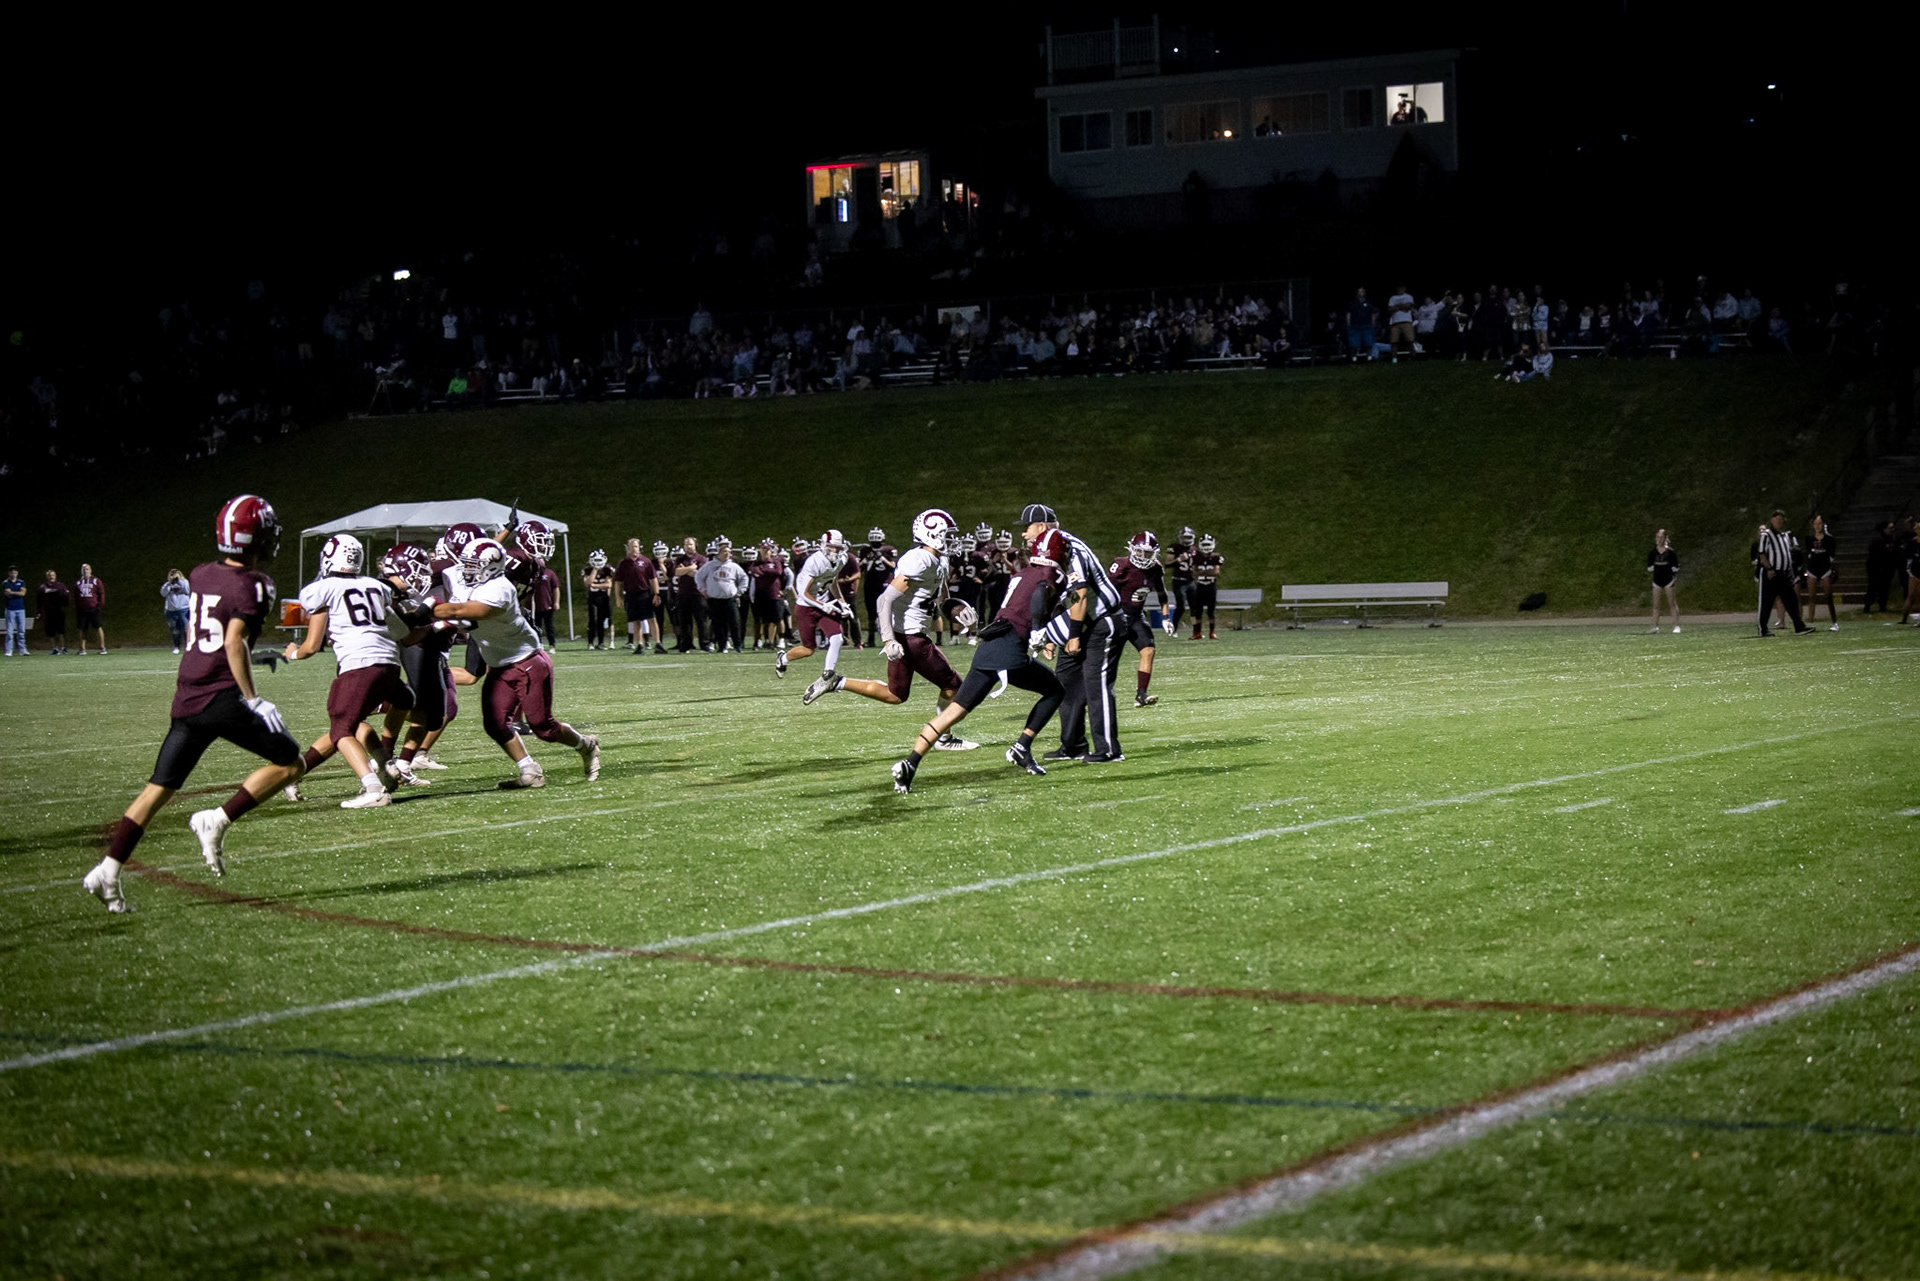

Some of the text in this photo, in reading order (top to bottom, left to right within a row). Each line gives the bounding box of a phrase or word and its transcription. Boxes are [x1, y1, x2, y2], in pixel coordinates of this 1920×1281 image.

[453, 530, 468, 545] 78
[347, 555, 359, 564] 60
[403, 546, 419, 558] 10
[505, 555, 521, 570] 77
[1109, 563, 1119, 574] 8
[1055, 569, 1064, 584] 7
[343, 588, 387, 626] 60
[186, 592, 225, 653] 15
